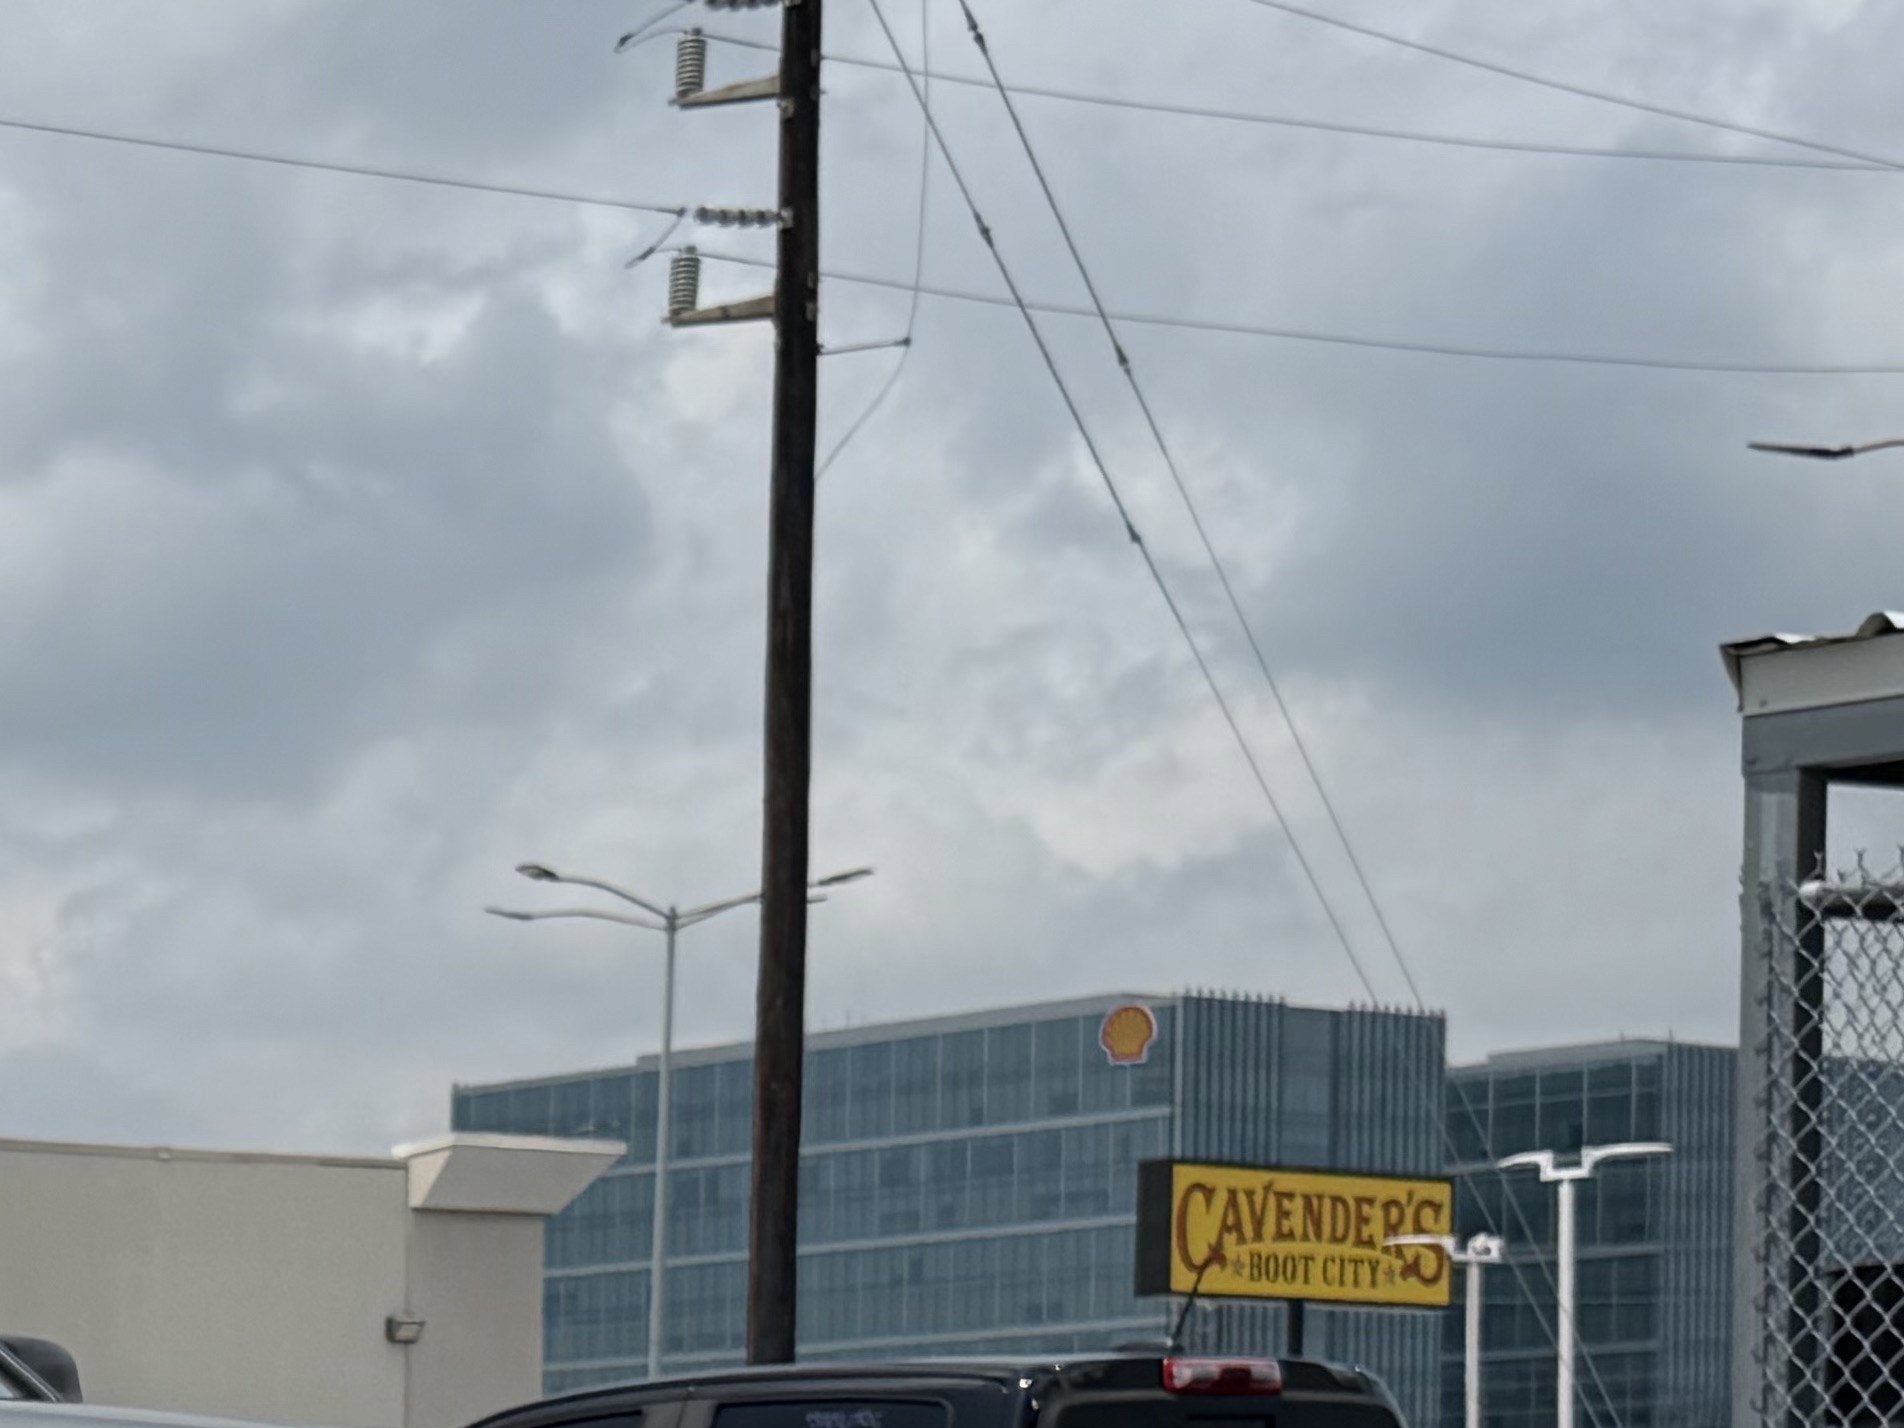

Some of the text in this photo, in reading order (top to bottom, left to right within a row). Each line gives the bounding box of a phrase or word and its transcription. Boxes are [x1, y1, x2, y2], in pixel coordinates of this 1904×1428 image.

[1176, 1180, 1444, 1287] CAVENDER'S
[1248, 1250, 1381, 1290] BOOT CITY
